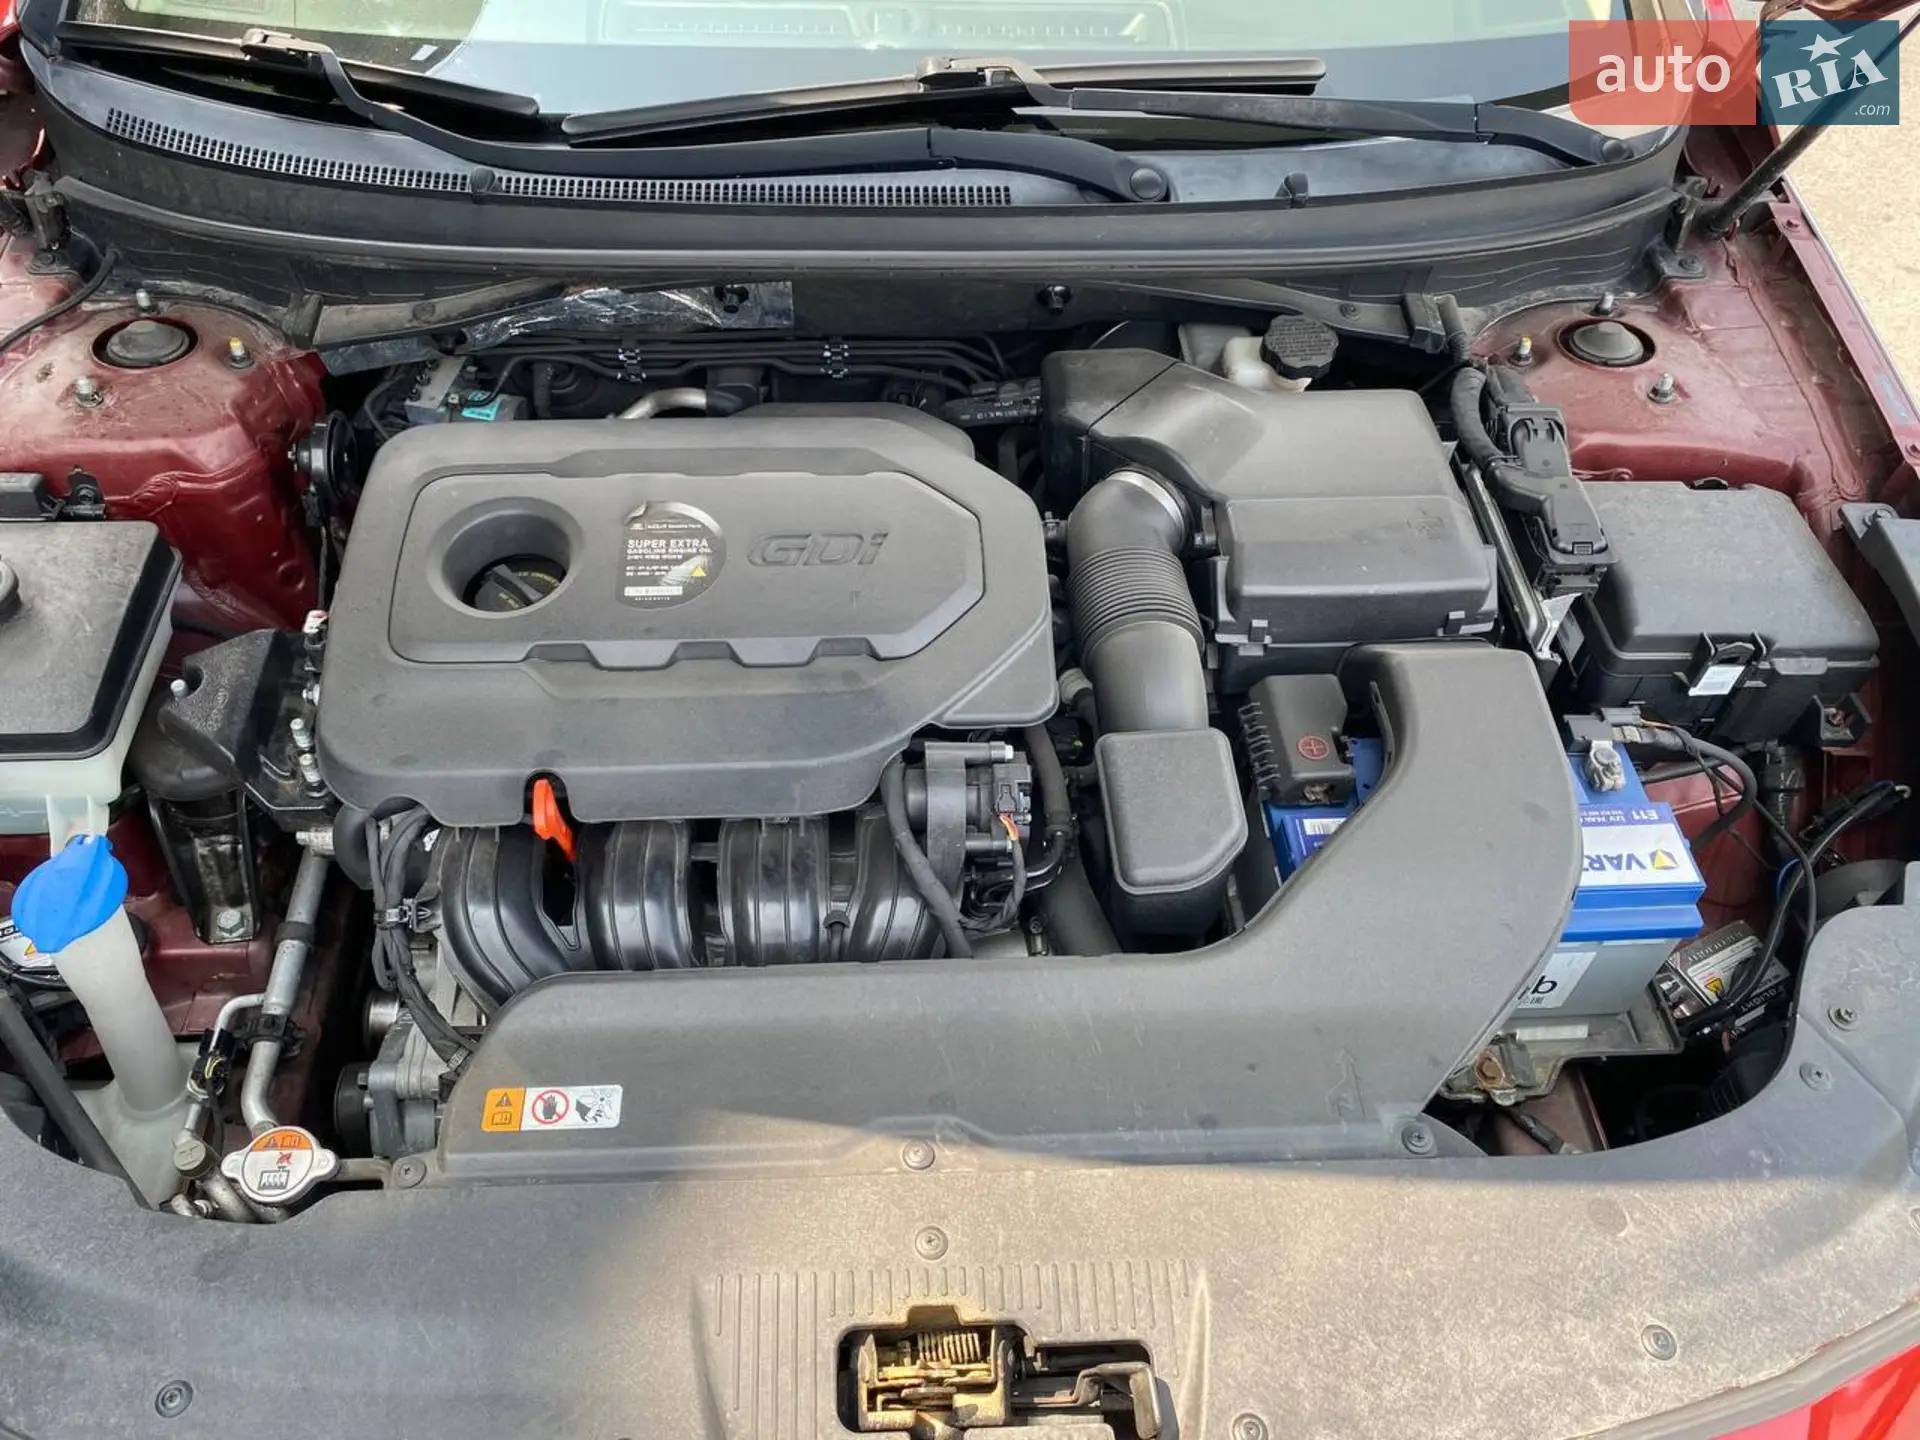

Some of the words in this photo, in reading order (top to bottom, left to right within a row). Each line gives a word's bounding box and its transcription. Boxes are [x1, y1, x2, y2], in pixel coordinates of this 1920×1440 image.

[627, 539, 667, 549] SUPER
[669, 538, 709, 548] EXTRA
[748, 532, 889, 567] GDi
[1632, 809, 1659, 820] E11
